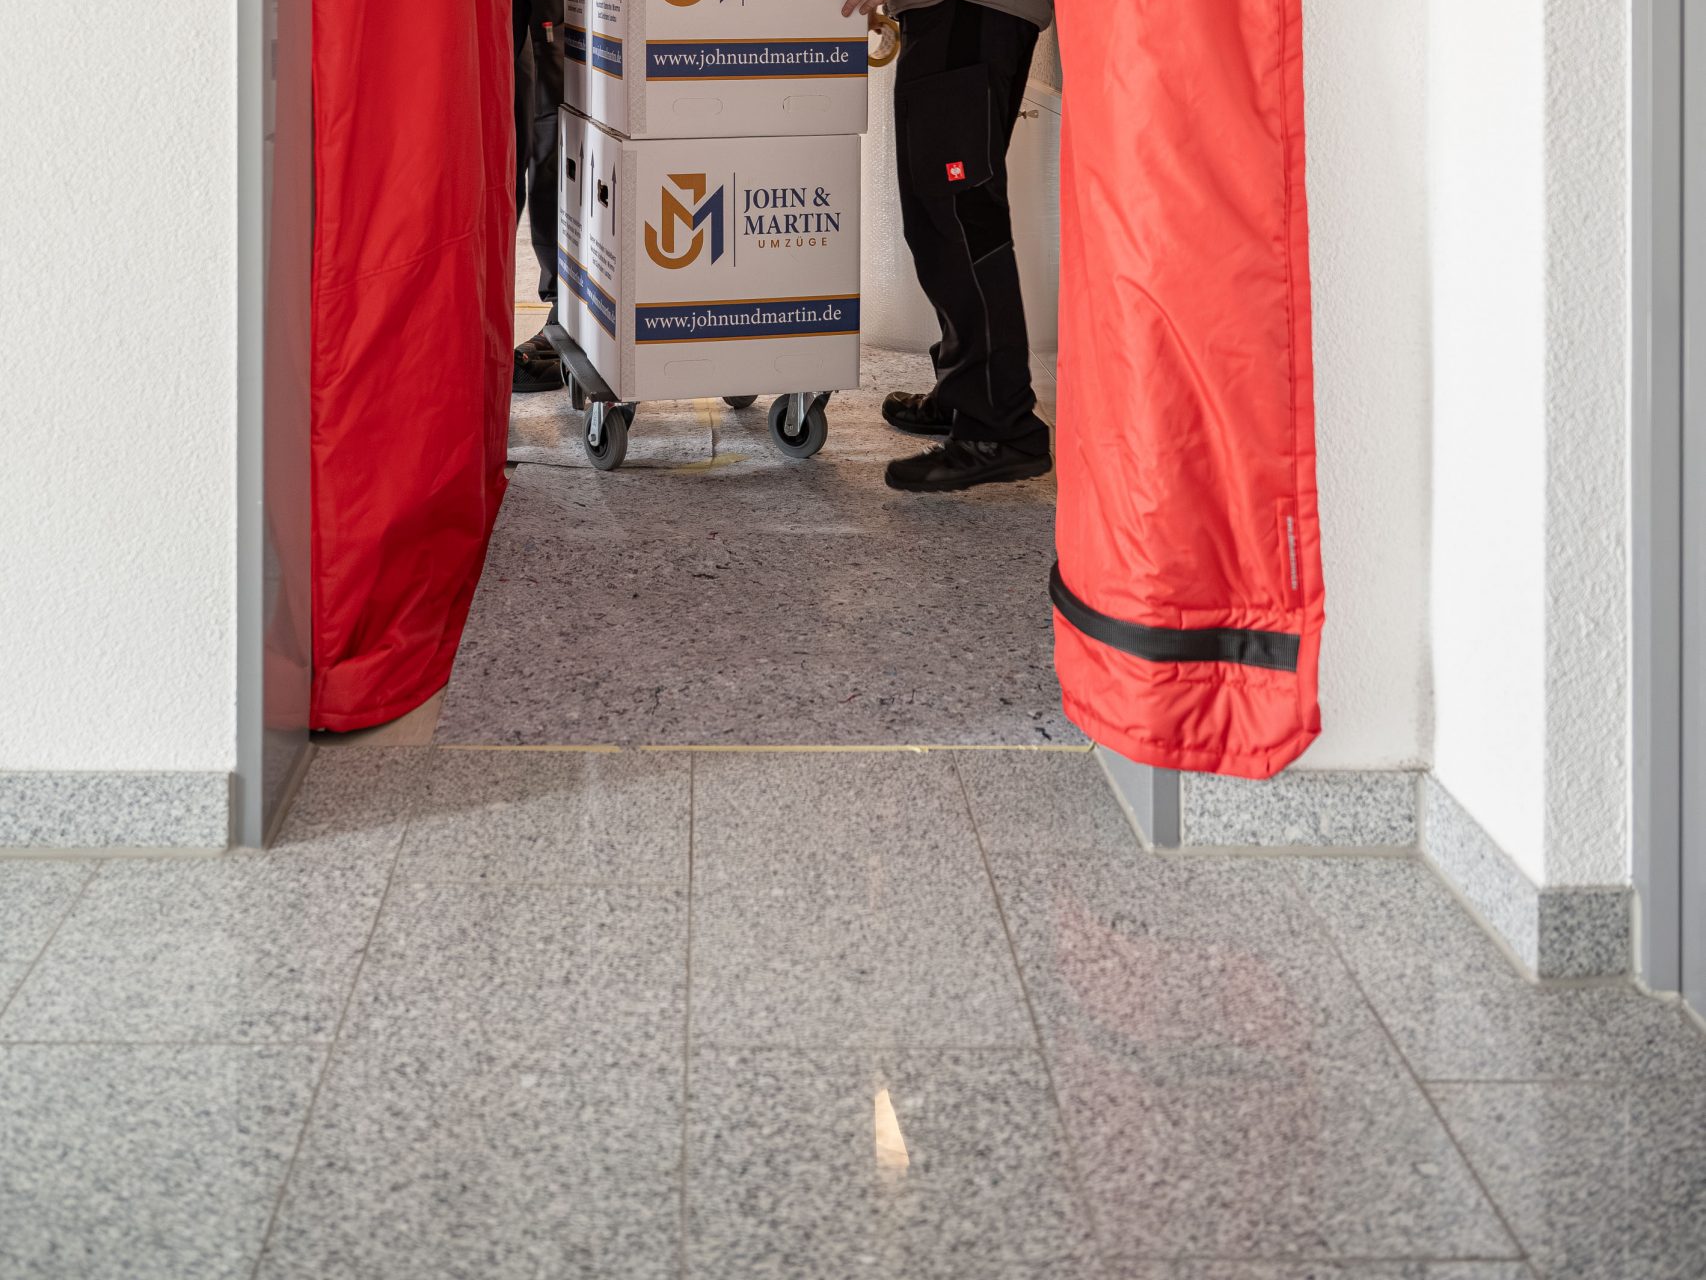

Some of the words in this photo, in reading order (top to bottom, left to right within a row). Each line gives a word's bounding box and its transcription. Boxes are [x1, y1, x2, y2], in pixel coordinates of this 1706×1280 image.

[653, 46, 849, 70] www.johnundmartin.de
[744, 187, 807, 213] JOHN
[812, 186, 831, 208] &
[743, 212, 841, 235] MARTIN
[757, 236, 829, 250] UMZÜGE
[644, 304, 843, 332] www.johnundmartin.de
